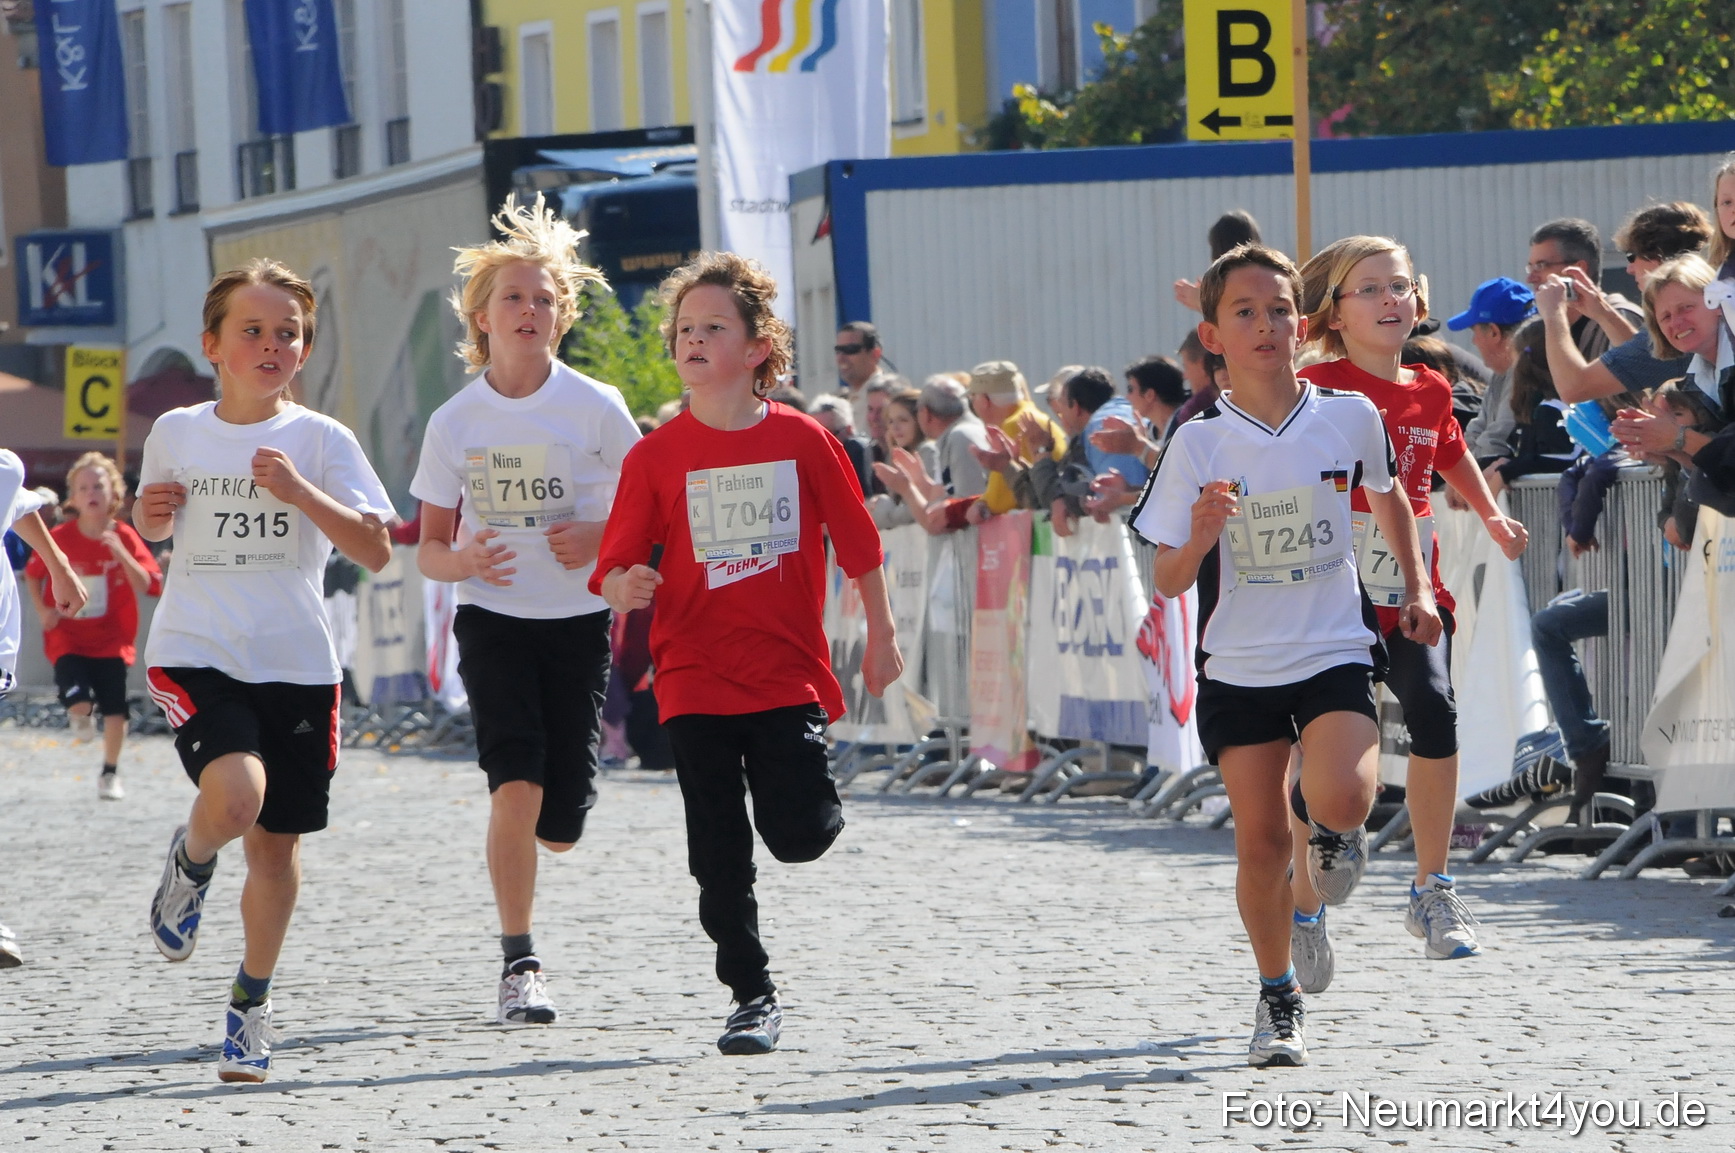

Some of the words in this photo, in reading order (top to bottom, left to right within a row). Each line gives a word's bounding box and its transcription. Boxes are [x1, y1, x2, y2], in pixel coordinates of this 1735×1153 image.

[1216, 9, 1276, 98] B
[80, 374, 110, 418] C
[492, 453, 522, 469] Nina
[191, 477, 260, 500] PATRICK
[497, 476, 564, 502] 7166
[716, 473, 764, 493] Fabian
[720, 496, 792, 529] 7046
[1251, 495, 1299, 520] Daniel
[214, 511, 289, 539] 7315
[1257, 519, 1335, 555] 7243
[762, 537, 798, 550] PFLEIDERER
[247, 552, 286, 561] PFLEIDERER
[726, 556, 760, 577] DEHN
[1303, 557, 1345, 576] PFLEIDERER
